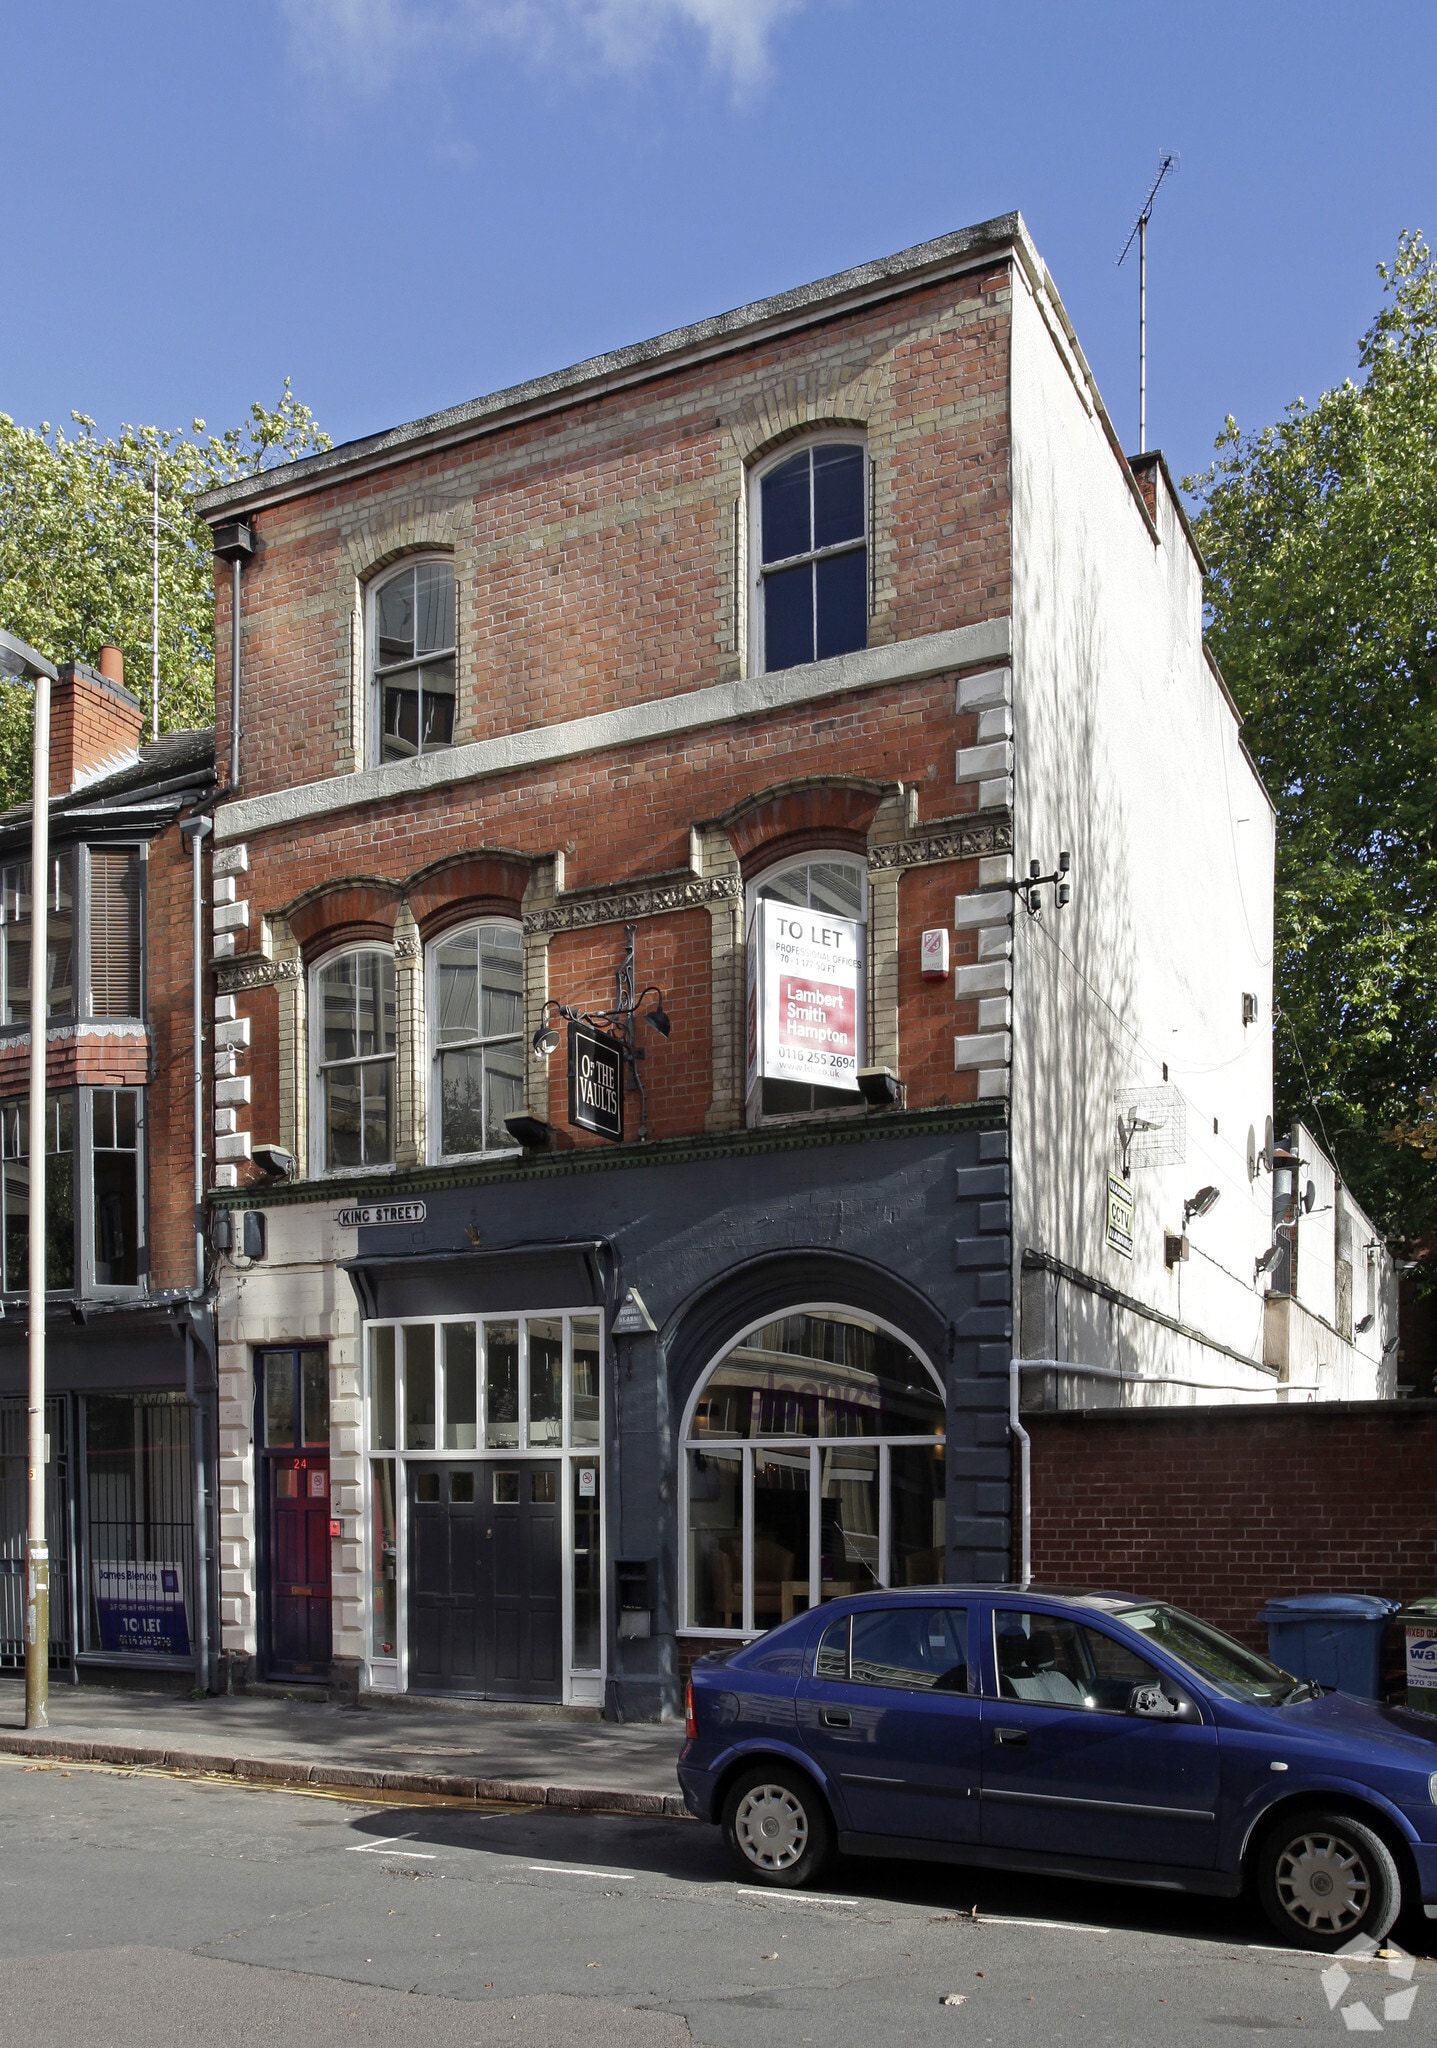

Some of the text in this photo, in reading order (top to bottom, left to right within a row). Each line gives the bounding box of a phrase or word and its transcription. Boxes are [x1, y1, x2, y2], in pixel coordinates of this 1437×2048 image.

[777, 917, 843, 948] TO LET
[776, 942, 862, 969] PROFESSIONAL OFFICES
[780, 954, 790, 963] 70
[827, 964, 836, 973] FT
[787, 983, 844, 1010] Lambert
[787, 1002, 826, 1024] Smith
[786, 1019, 848, 1045] Hampton
[779, 1046, 855, 1069] 0116 255 2694
[596, 1061, 614, 1089] THE
[579, 1075, 617, 1115] VAULTS
[342, 1205, 419, 1224] KING STREET
[1111, 1203, 1129, 1229] CCTV
[293, 1459, 307, 1469] 24
[100, 1569, 158, 1581] James Blenkin
[123, 1617, 161, 1633] TO LET
[1410, 1649, 1437, 1660] wa
